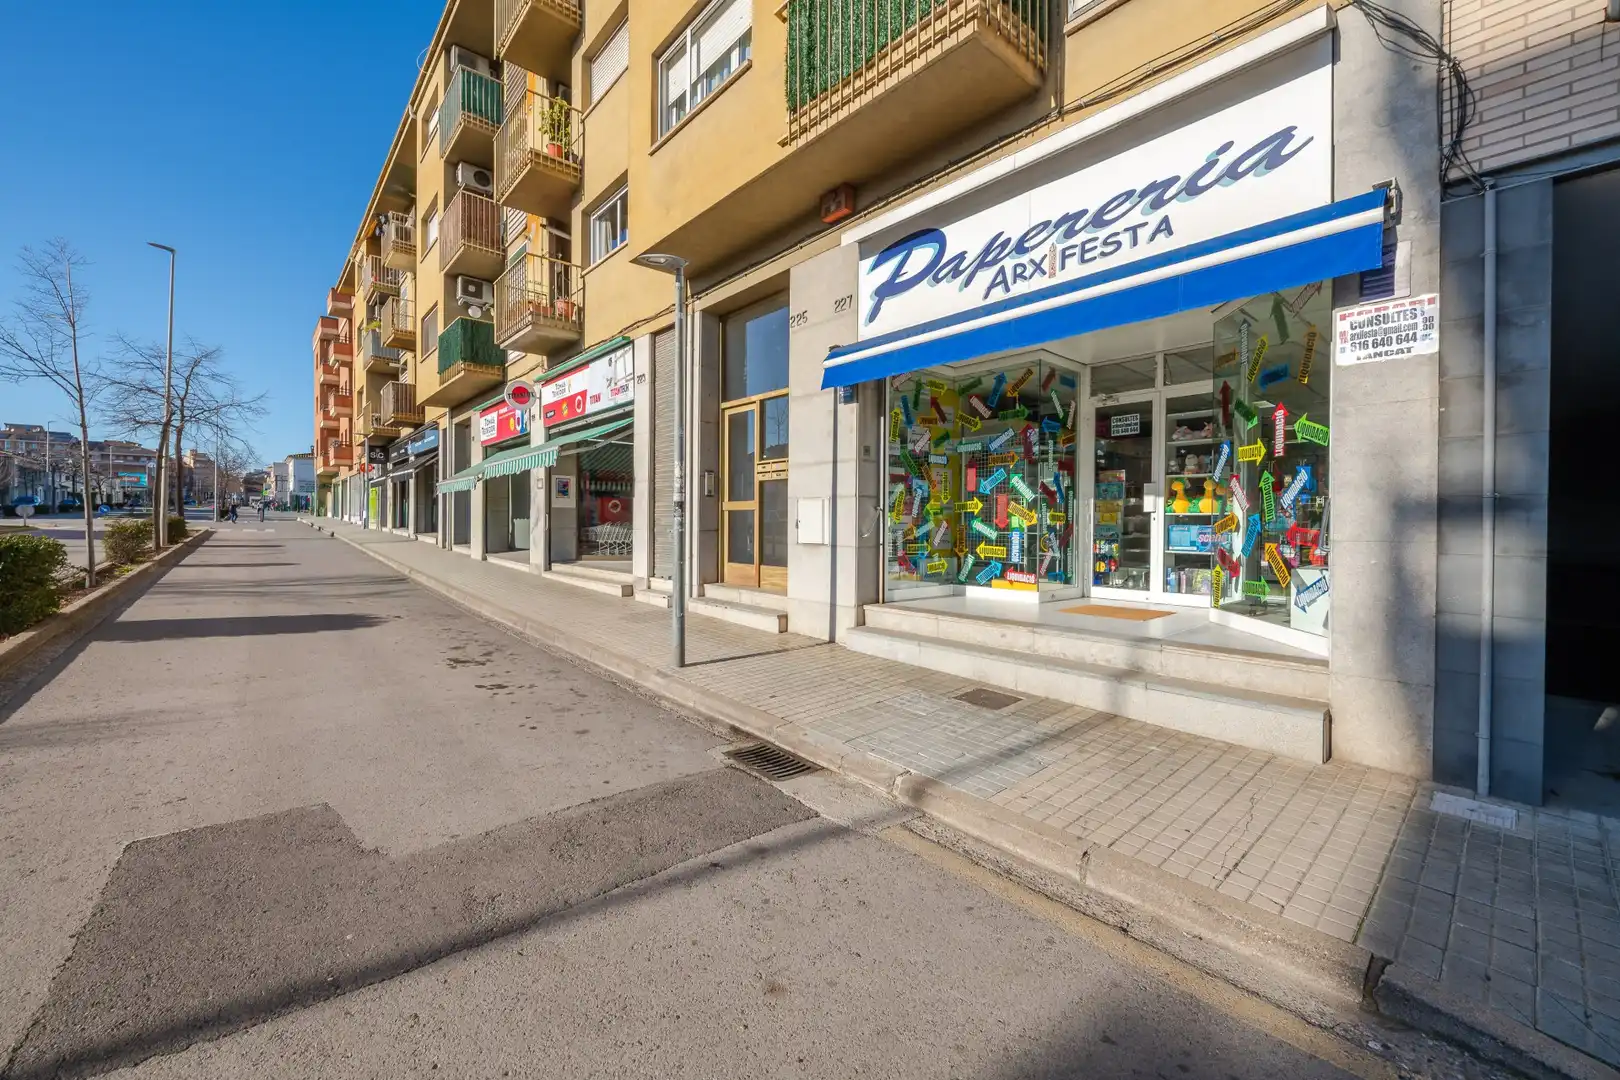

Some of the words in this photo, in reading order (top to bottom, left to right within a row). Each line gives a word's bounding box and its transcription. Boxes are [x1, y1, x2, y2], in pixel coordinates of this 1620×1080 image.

[864, 125, 1314, 326] Papereria
[834, 294, 853, 313] 227
[789, 310, 808, 328] 225
[1372, 335, 1393, 349] 640
[1395, 331, 1418, 345] 644
[1247, 338, 1267, 382] LIQUIDACIÓ
[1299, 331, 1317, 383] LIQUIDACIÓ
[1275, 409, 1284, 457] LIQUIDACIÓ
[1298, 421, 1328, 444] LIQUIDACIÓ
[1281, 468, 1308, 509] LIQUIDACIÓ
[980, 546, 1006, 557] LIQUIDACIÓ
[1266, 545, 1289, 586] LIQUIDACIÓ
[1007, 572, 1036, 584] LIQUIDACIÓ
[1297, 578, 1328, 607] LIQUIDACIÓ
